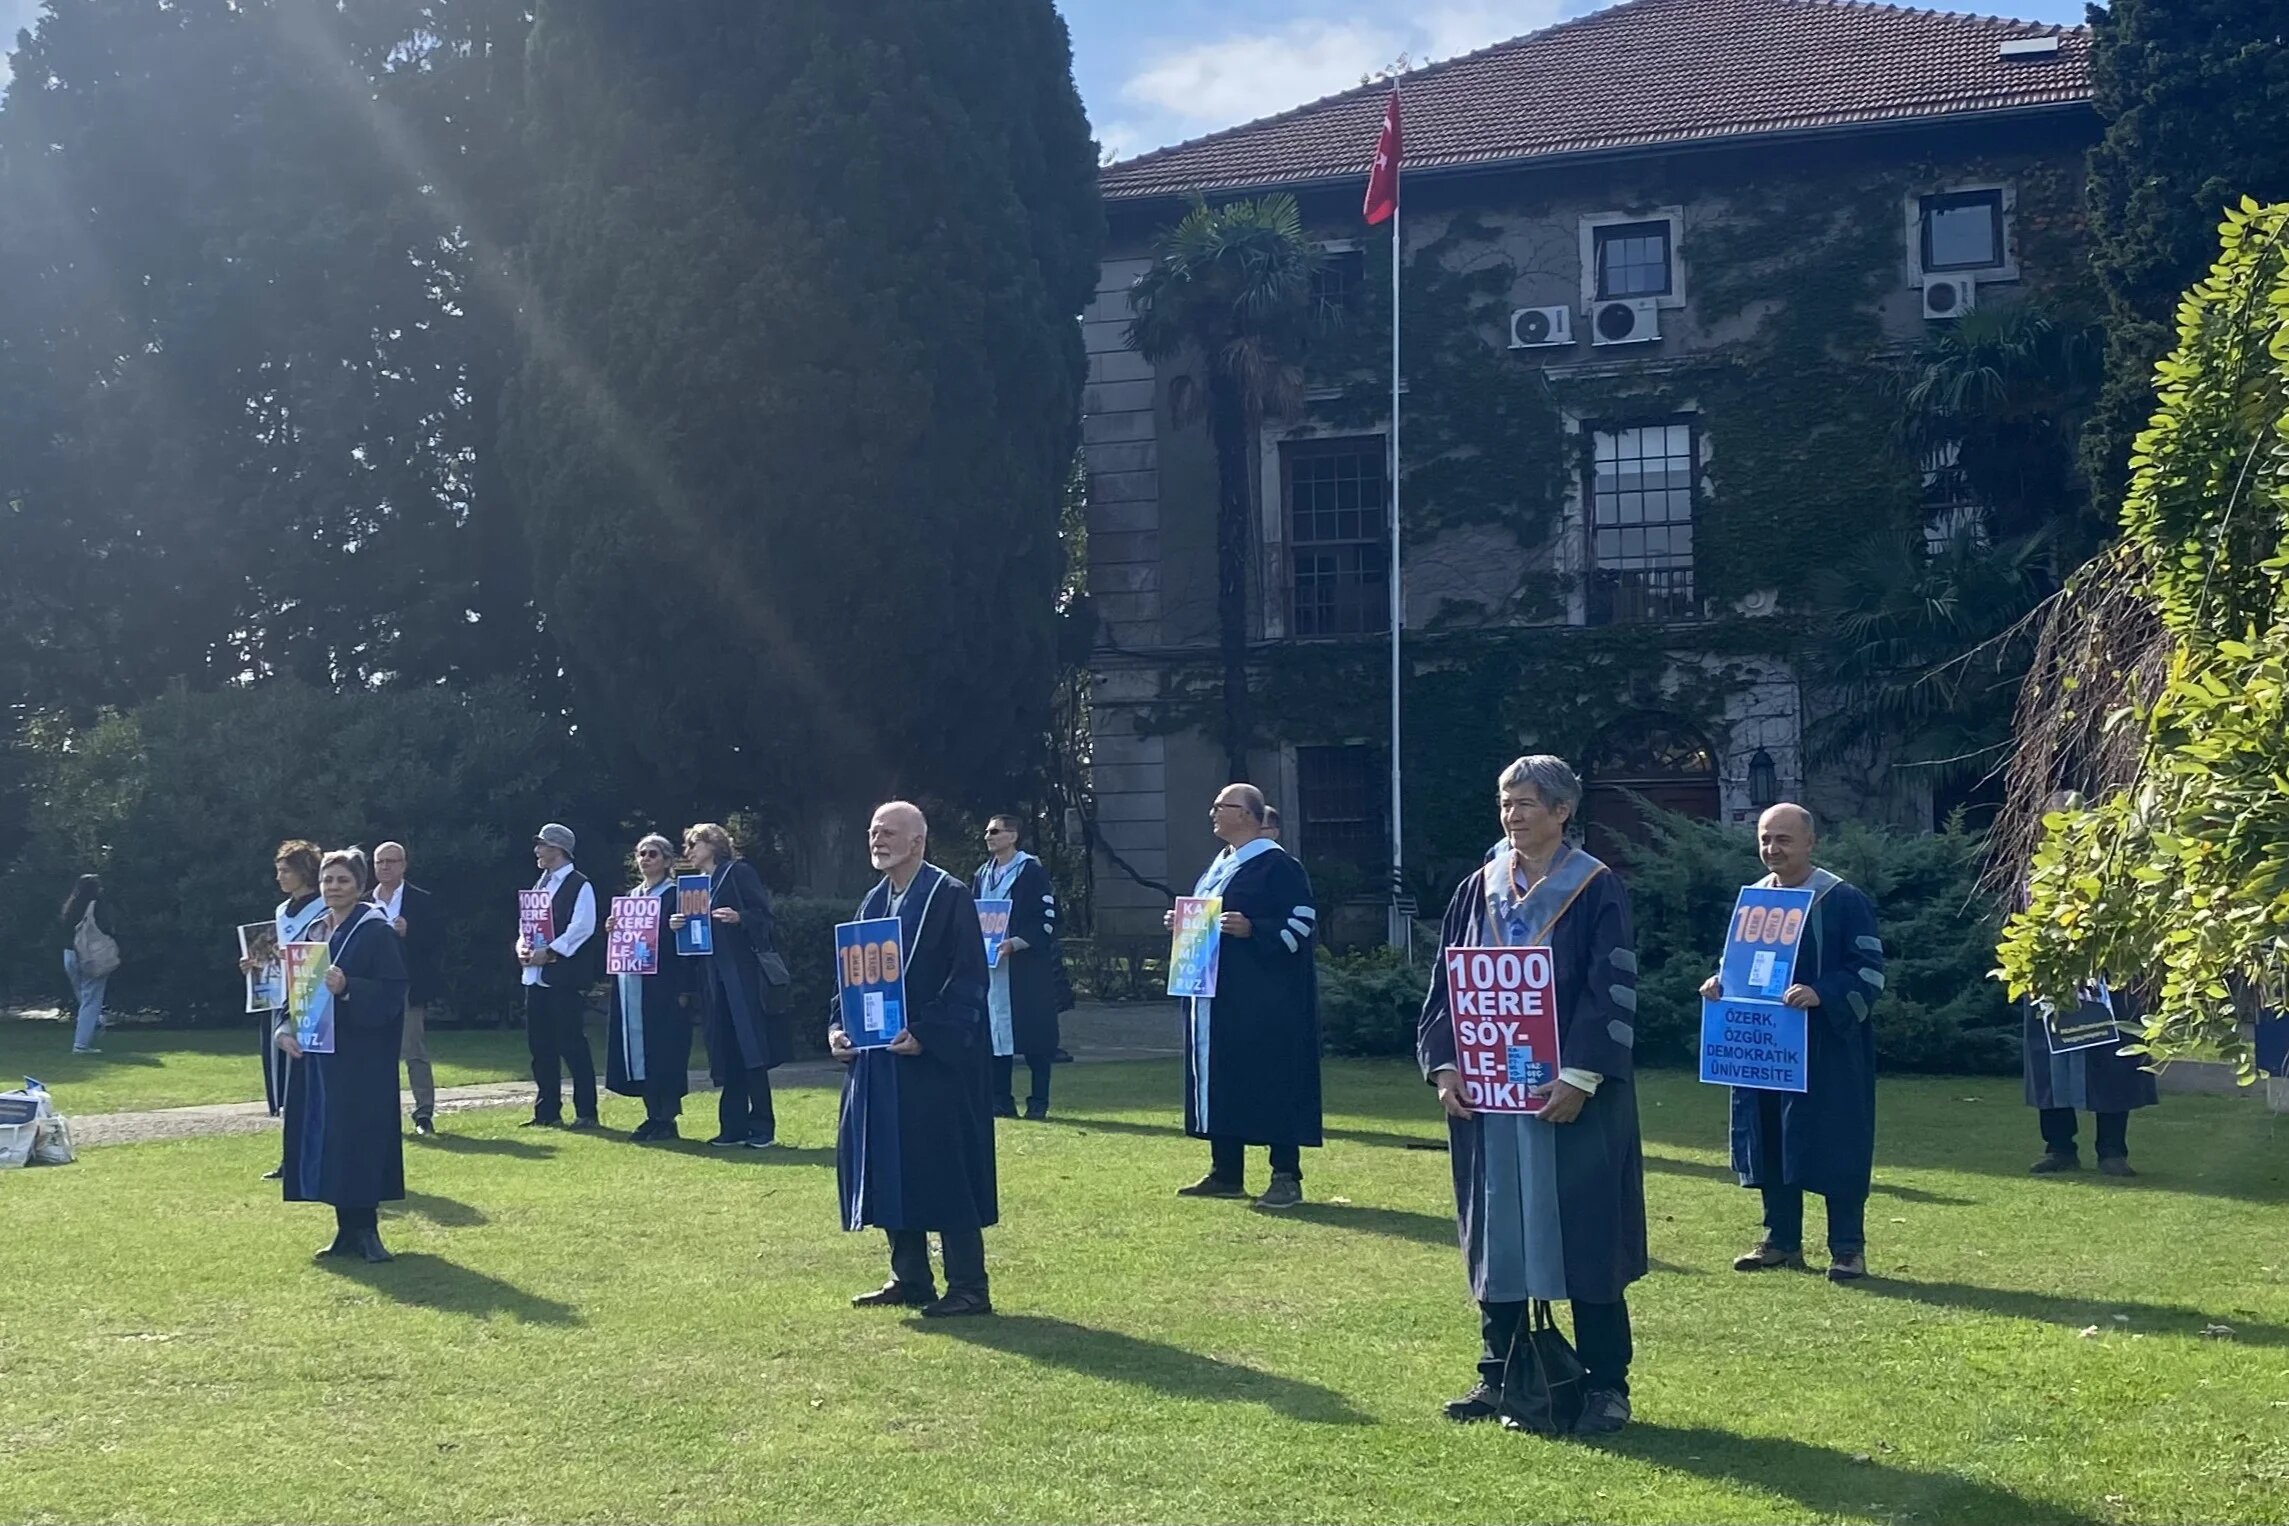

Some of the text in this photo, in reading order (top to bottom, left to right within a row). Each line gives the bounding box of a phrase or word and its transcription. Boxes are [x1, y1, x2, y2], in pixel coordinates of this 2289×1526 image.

[520, 893, 549, 909] 1000
[613, 899, 659, 917] 1000
[614, 916, 654, 929] KERE
[1734, 905, 1803, 945] 1000
[611, 944, 635, 957] LE-
[840, 940, 899, 987] 1000
[1449, 953, 1550, 990] 1000
[1456, 991, 1544, 1016] KERE
[1725, 1007, 1777, 1029] ÖZERK,
[1460, 1016, 1529, 1046] SÖY-
[1723, 1028, 1778, 1047] ÖZGÜR,
[1463, 1051, 1506, 1077] LE-
[1706, 1043, 1799, 1065] DEMOKRATİK
[1710, 1061, 1793, 1084] ÜNİVERSİTE
[1466, 1076, 1526, 1108] DİK!
